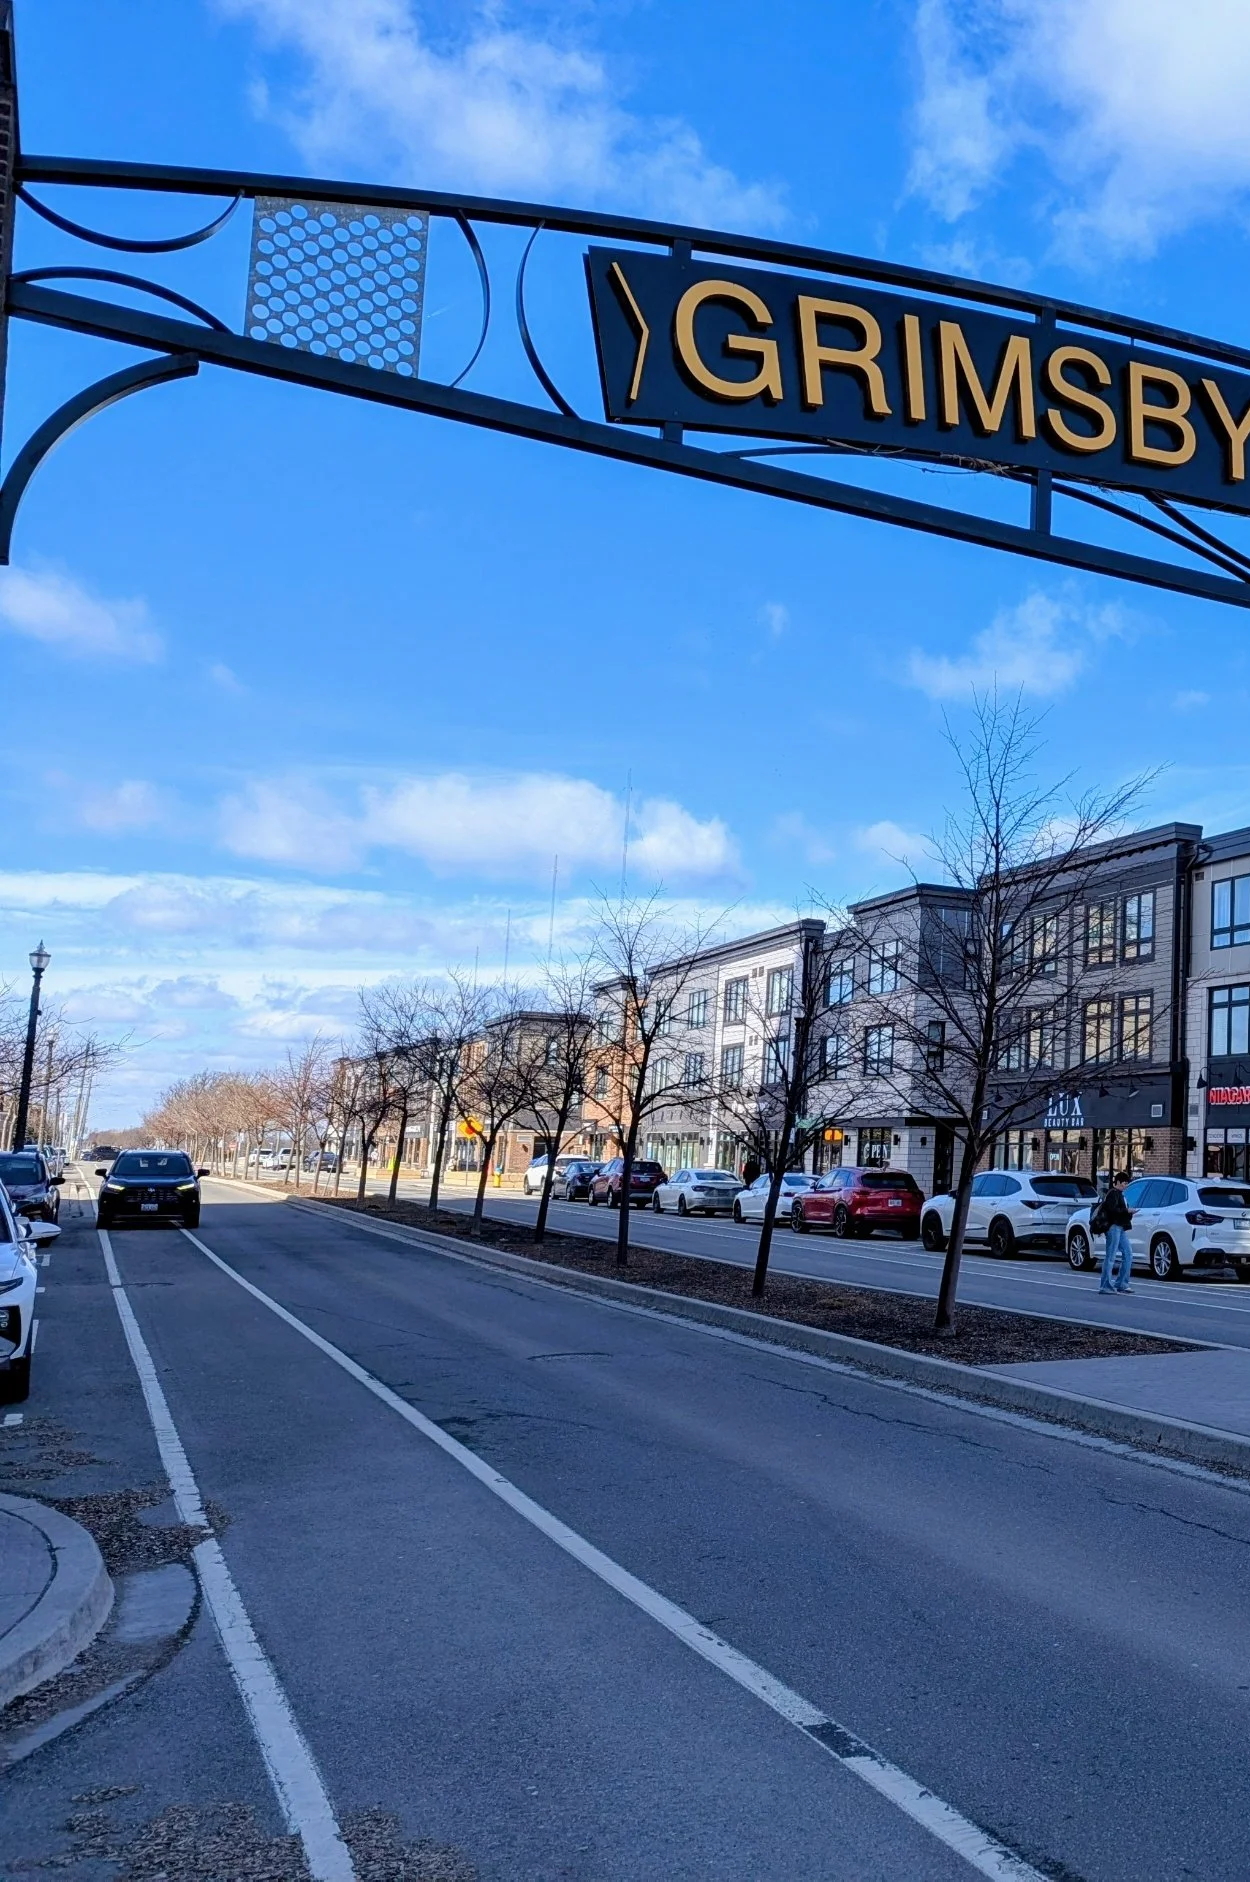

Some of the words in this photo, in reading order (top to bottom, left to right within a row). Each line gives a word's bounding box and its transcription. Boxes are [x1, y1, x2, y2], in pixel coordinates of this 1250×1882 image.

[1046, 1091, 1083, 1117] LUX
[1043, 1118, 1070, 1128] BEAUTY
[1071, 1117, 1085, 1127] BAR
